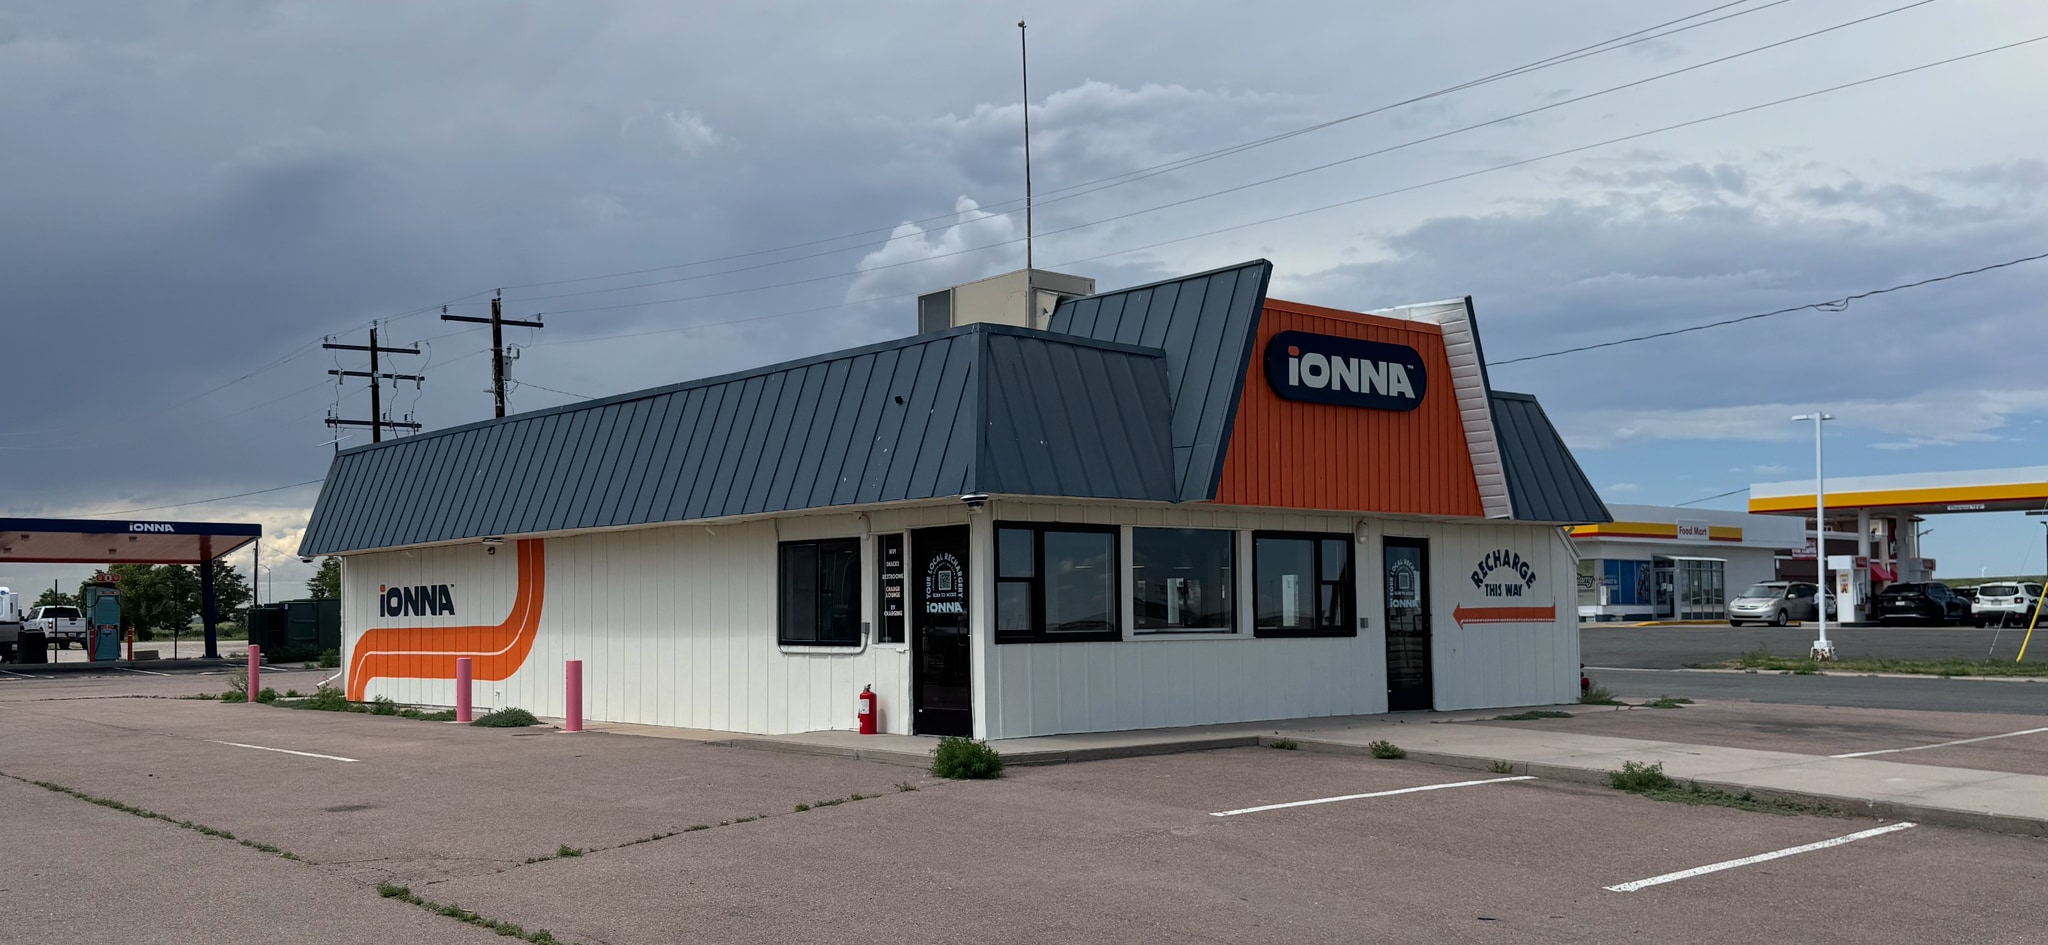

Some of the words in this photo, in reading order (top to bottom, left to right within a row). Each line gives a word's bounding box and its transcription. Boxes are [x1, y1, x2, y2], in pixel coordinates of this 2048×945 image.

[1288, 346, 1415, 399] iONNA
[129, 522, 174, 532] iONNA
[1679, 526, 1692, 535] Food
[1694, 527, 1707, 536] Mart
[928, 553, 943, 574] LOCAL
[944, 553, 963, 598] RECHARGERY
[1471, 549, 1536, 589] RECHARGE
[1485, 583, 1502, 597] THIS
[1505, 583, 1523, 597] WAY
[380, 584, 455, 617] iONNA
[926, 602, 963, 613] iONNA
[1390, 599, 1418, 608] iONNA
